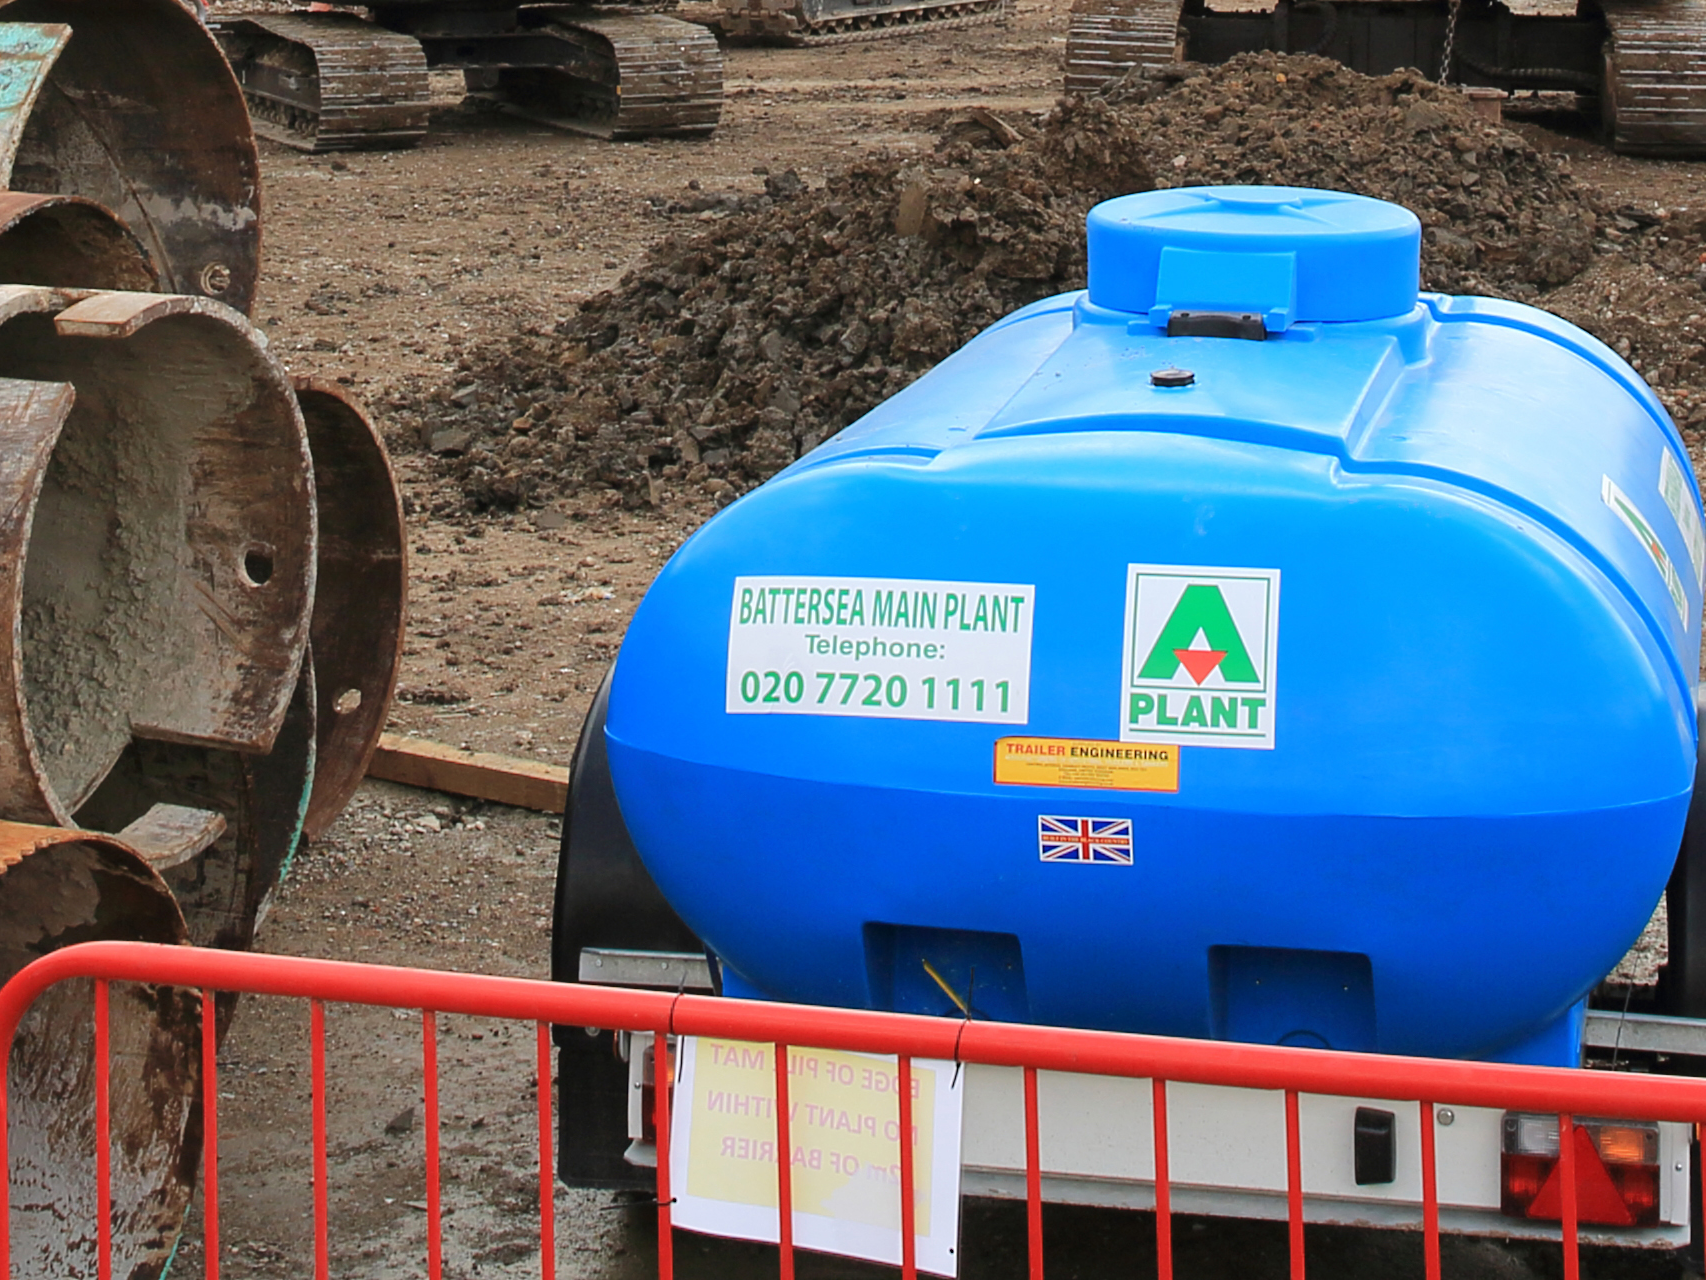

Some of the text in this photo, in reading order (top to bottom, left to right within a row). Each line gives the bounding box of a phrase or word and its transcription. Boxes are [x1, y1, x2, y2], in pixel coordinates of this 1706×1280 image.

[738, 586, 1026, 634] BATTERSEA MAIN PLANT
[804, 634, 947, 661] Telephone:
[740, 670, 1011, 715] 020 7720 1111
[1129, 692, 1267, 730] PLANT
[1006, 742, 1066, 757] TRAILER
[1070, 746, 1169, 761] ENGINEERING
